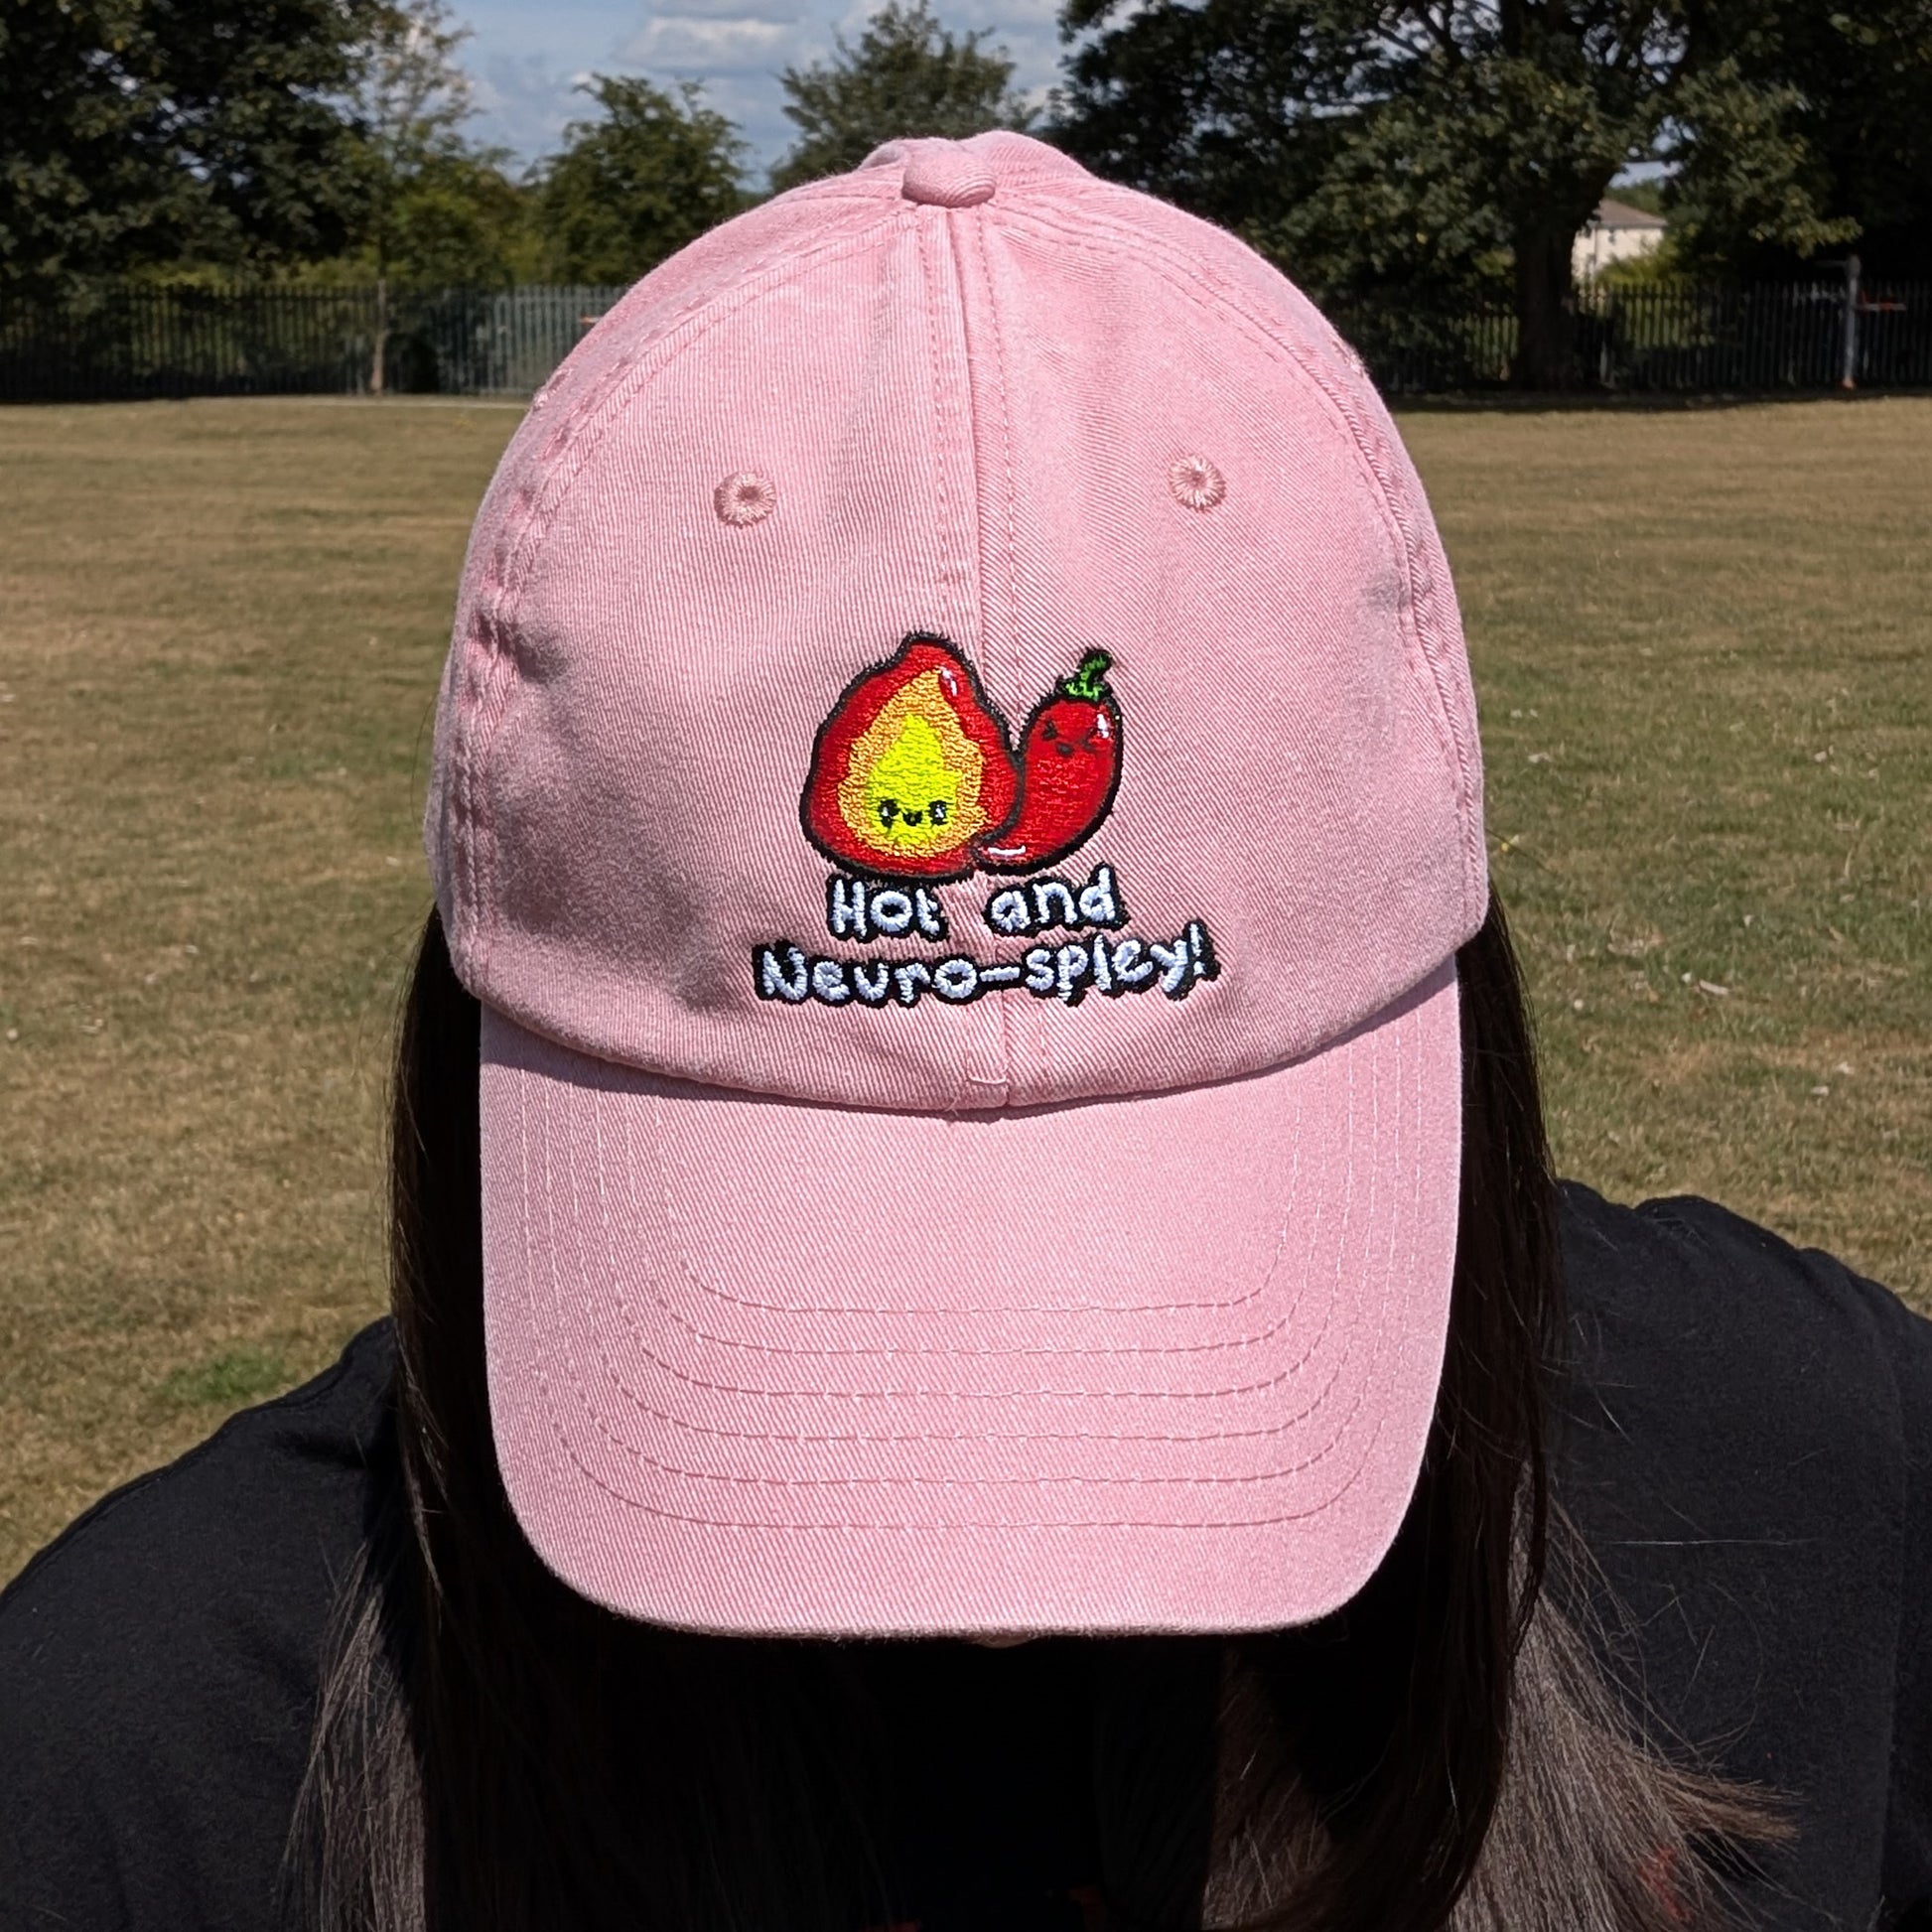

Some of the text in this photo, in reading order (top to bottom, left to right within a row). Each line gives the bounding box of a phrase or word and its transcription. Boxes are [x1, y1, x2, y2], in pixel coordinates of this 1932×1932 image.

[829, 864, 1122, 940] Hot and
[758, 919, 1213, 1005] Neuro-spicy!
